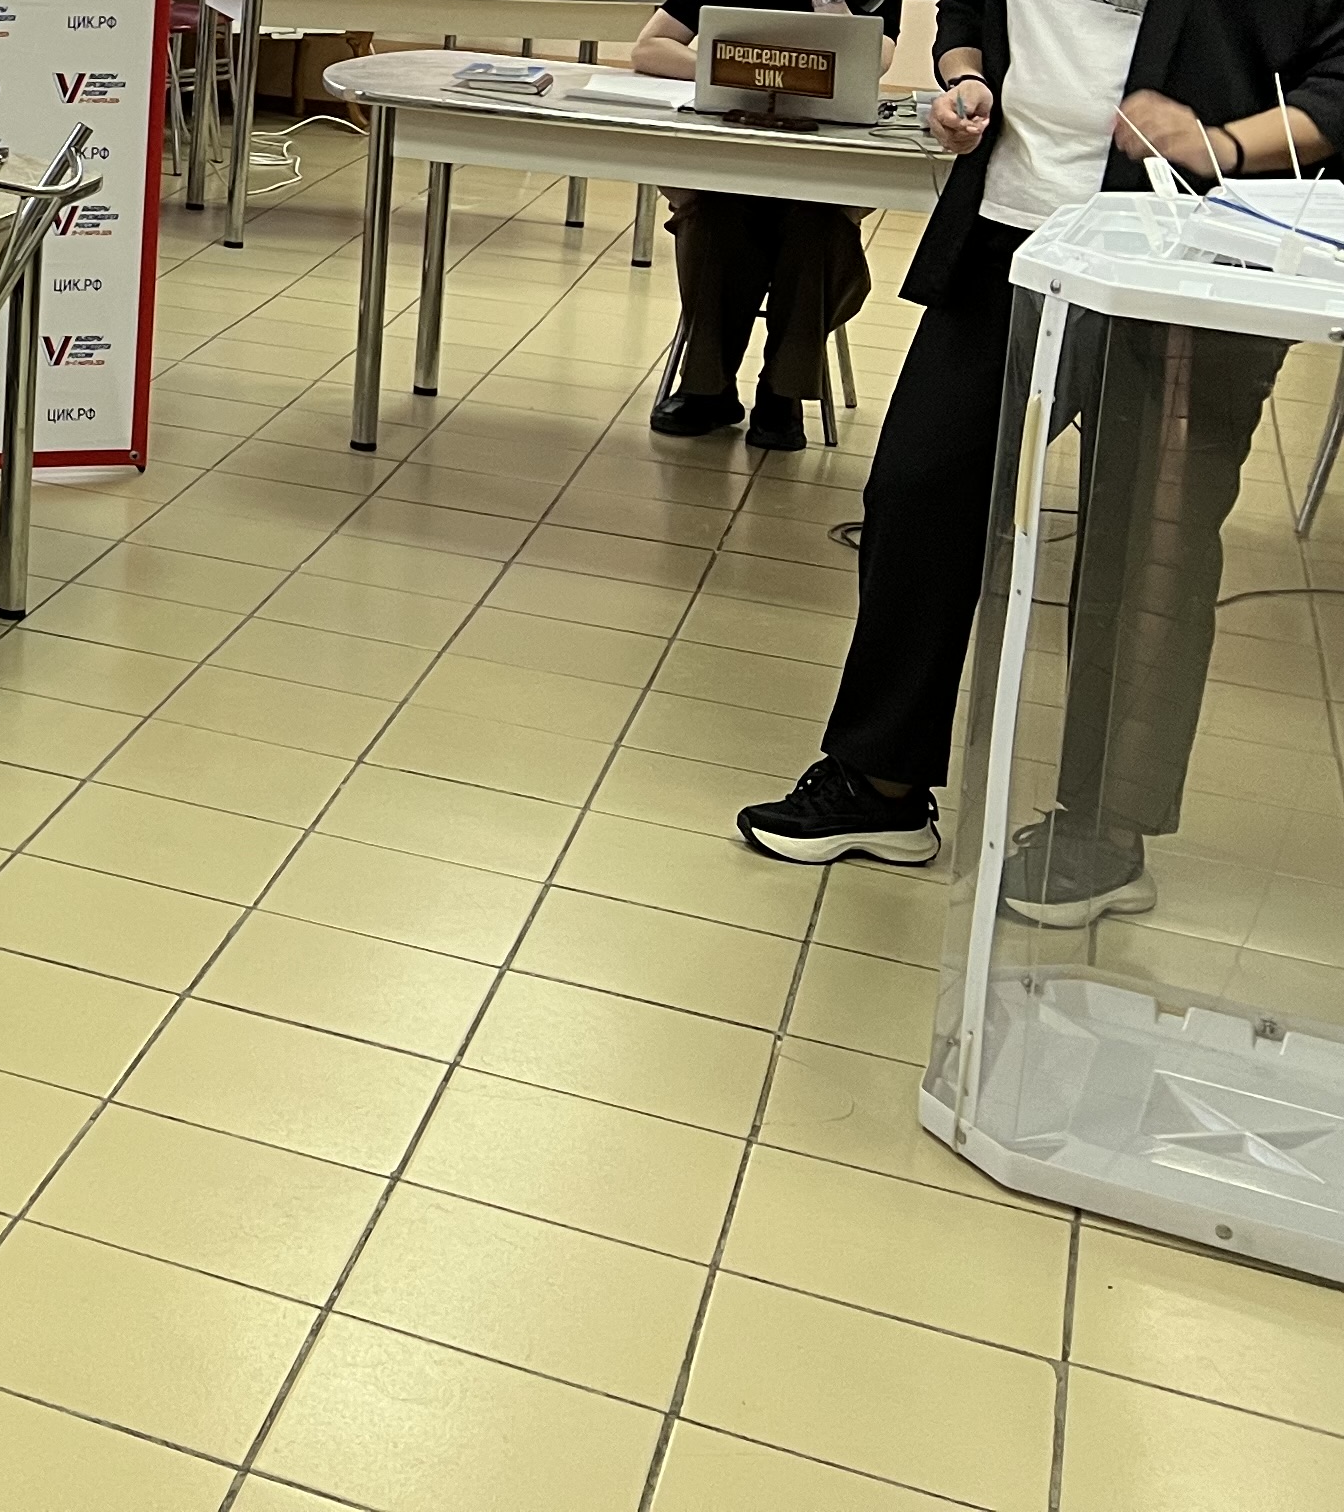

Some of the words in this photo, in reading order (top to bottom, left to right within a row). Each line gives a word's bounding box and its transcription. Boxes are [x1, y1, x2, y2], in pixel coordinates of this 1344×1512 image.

[67, 15, 117, 29] ЦИК.РФ
[754, 68, 784, 88] УИК
[53, 278, 102, 294] ЦИК.РФ
[47, 407, 96, 423] ЦИК.РФ
